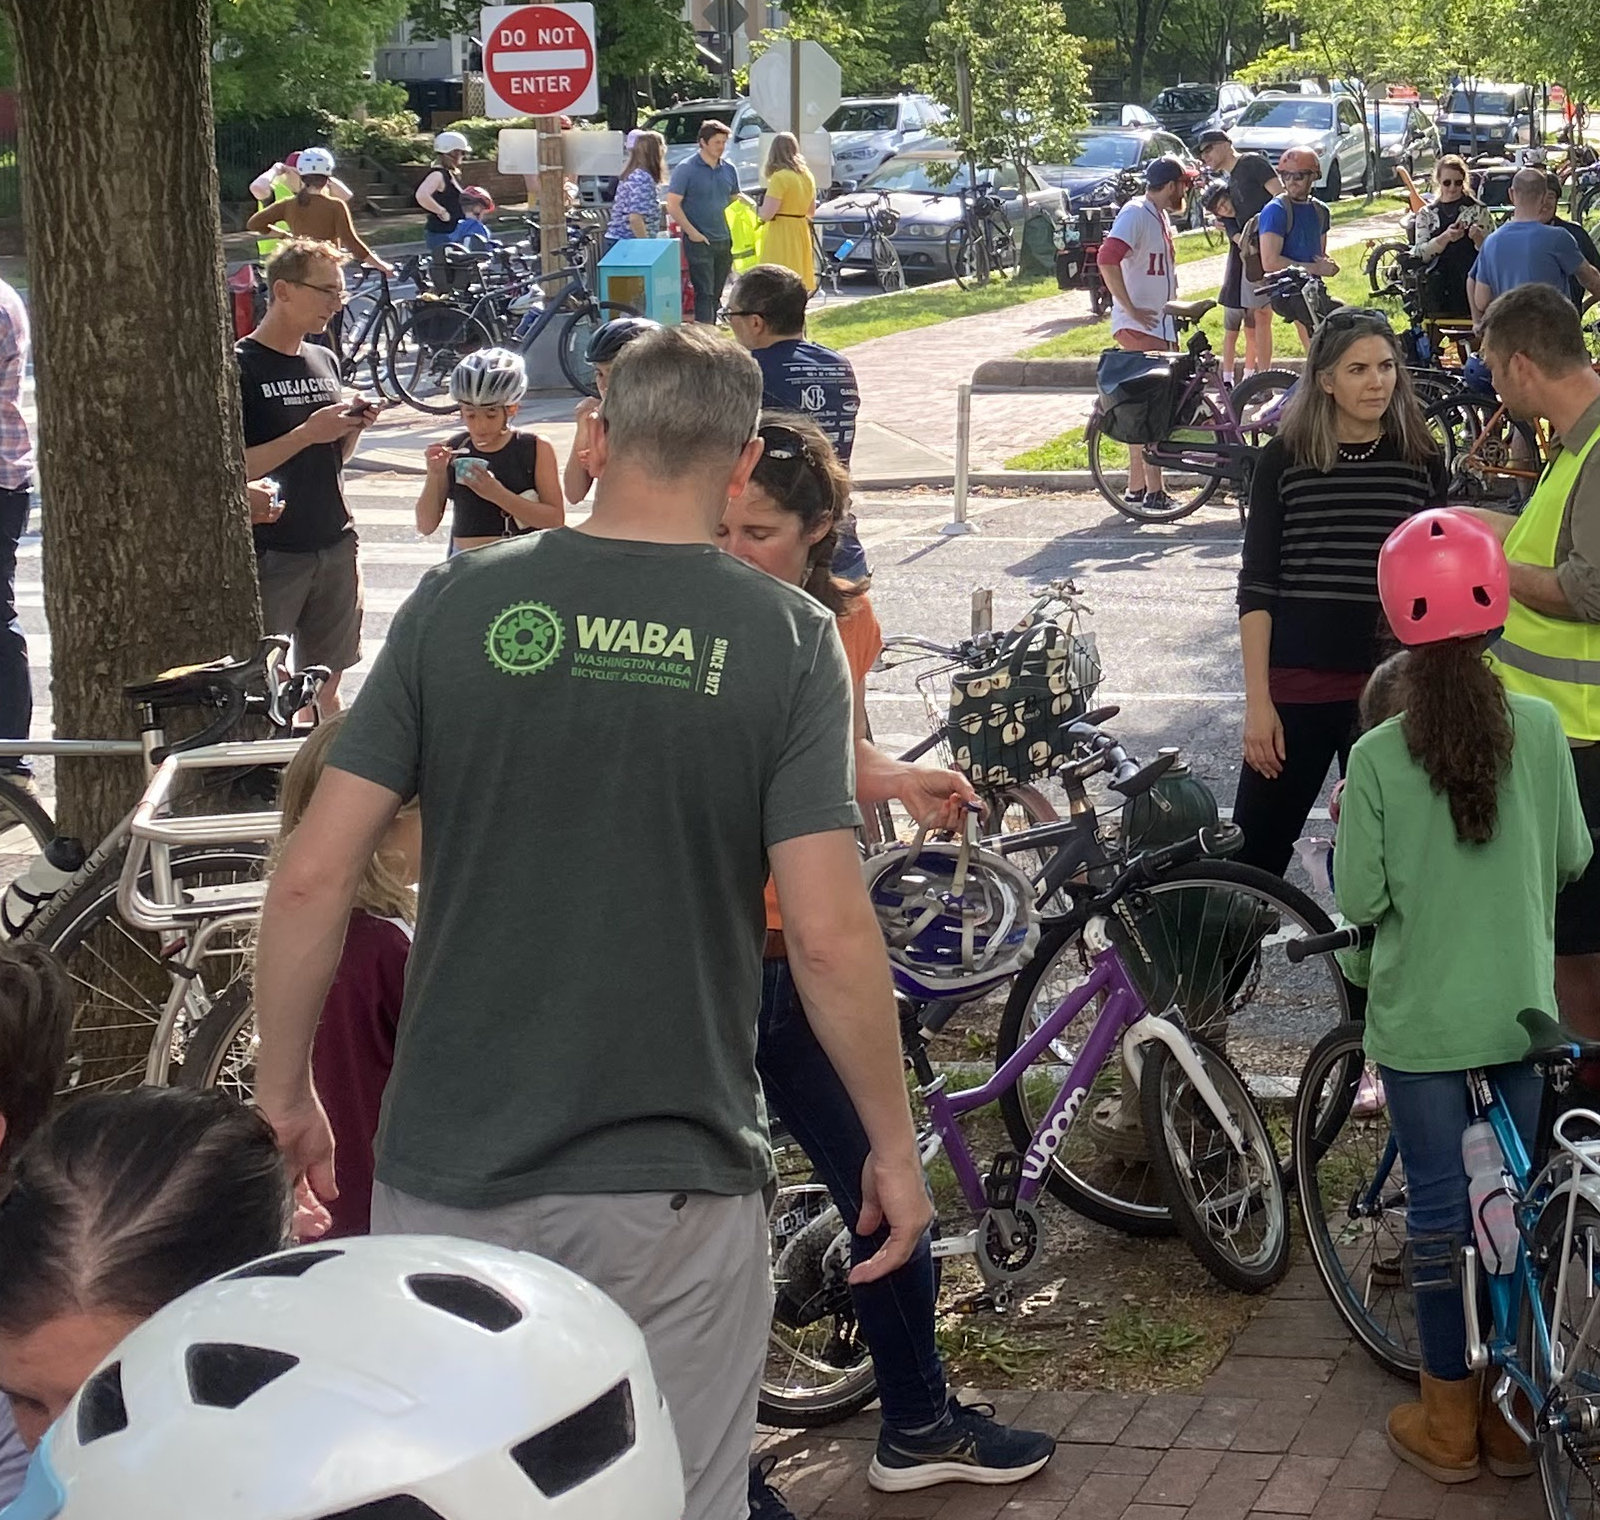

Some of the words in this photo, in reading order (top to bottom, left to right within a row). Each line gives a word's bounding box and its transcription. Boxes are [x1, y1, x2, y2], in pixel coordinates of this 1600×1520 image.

[500, 29, 526, 47] DO
[537, 26, 576, 45] NOT
[510, 75, 571, 95] ENTER
[575, 615, 695, 661] WABA
[573, 652, 656, 671] WASHINGTON
[657, 661, 692, 677] AREA
[708, 637, 729, 671] SINCE
[571, 666, 620, 682] BICYCLIST
[621, 671, 691, 689] ASSOCIATION
[704, 671, 721, 696] 1972
[1022, 1086, 1087, 1180] woom
